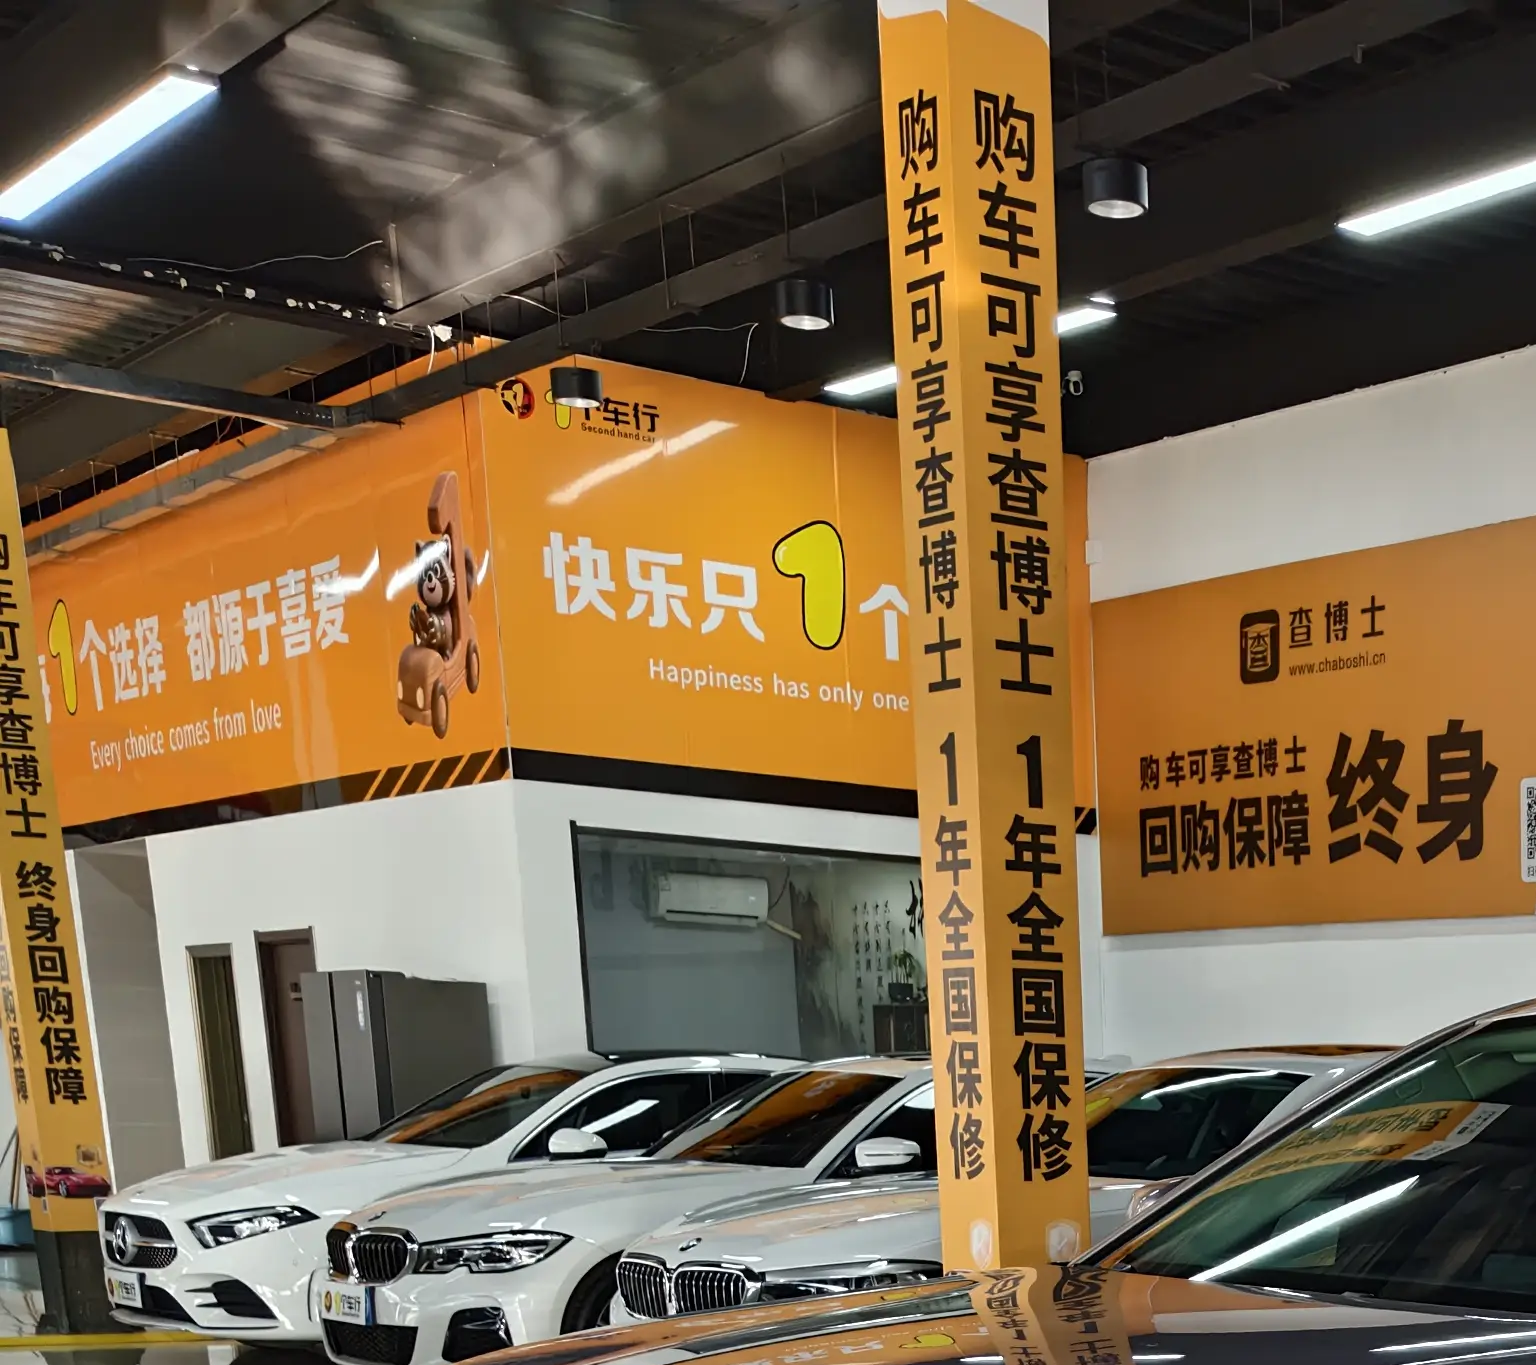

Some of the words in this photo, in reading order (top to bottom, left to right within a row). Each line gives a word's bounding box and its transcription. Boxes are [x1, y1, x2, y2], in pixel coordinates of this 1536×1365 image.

[973, 89, 1056, 697] 购车可享查博士
[898, 88, 964, 694] 购车可享查博士
[934, 731, 986, 1181] 1年全国保修
[1288, 595, 1386, 649] 查博士
[1288, 651, 1386, 677] www.chaboshi.cn
[649, 657, 763, 696] Happiness
[772, 673, 810, 700] has
[819, 681, 864, 712] only
[872, 691, 910, 712] one
[89, 740, 121, 772] Every
[124, 726, 165, 761] choice
[169, 719, 211, 751] comes
[213, 707, 247, 742] from
[250, 699, 283, 734] love
[1139, 735, 1307, 791] 购车可享查博士
[1139, 790, 1311, 878] 回购保障
[1326, 719, 1499, 864] 终身
[15, 860, 88, 1105] 终身回购保障
[1004, 734, 1075, 1183] 1年全国保修
